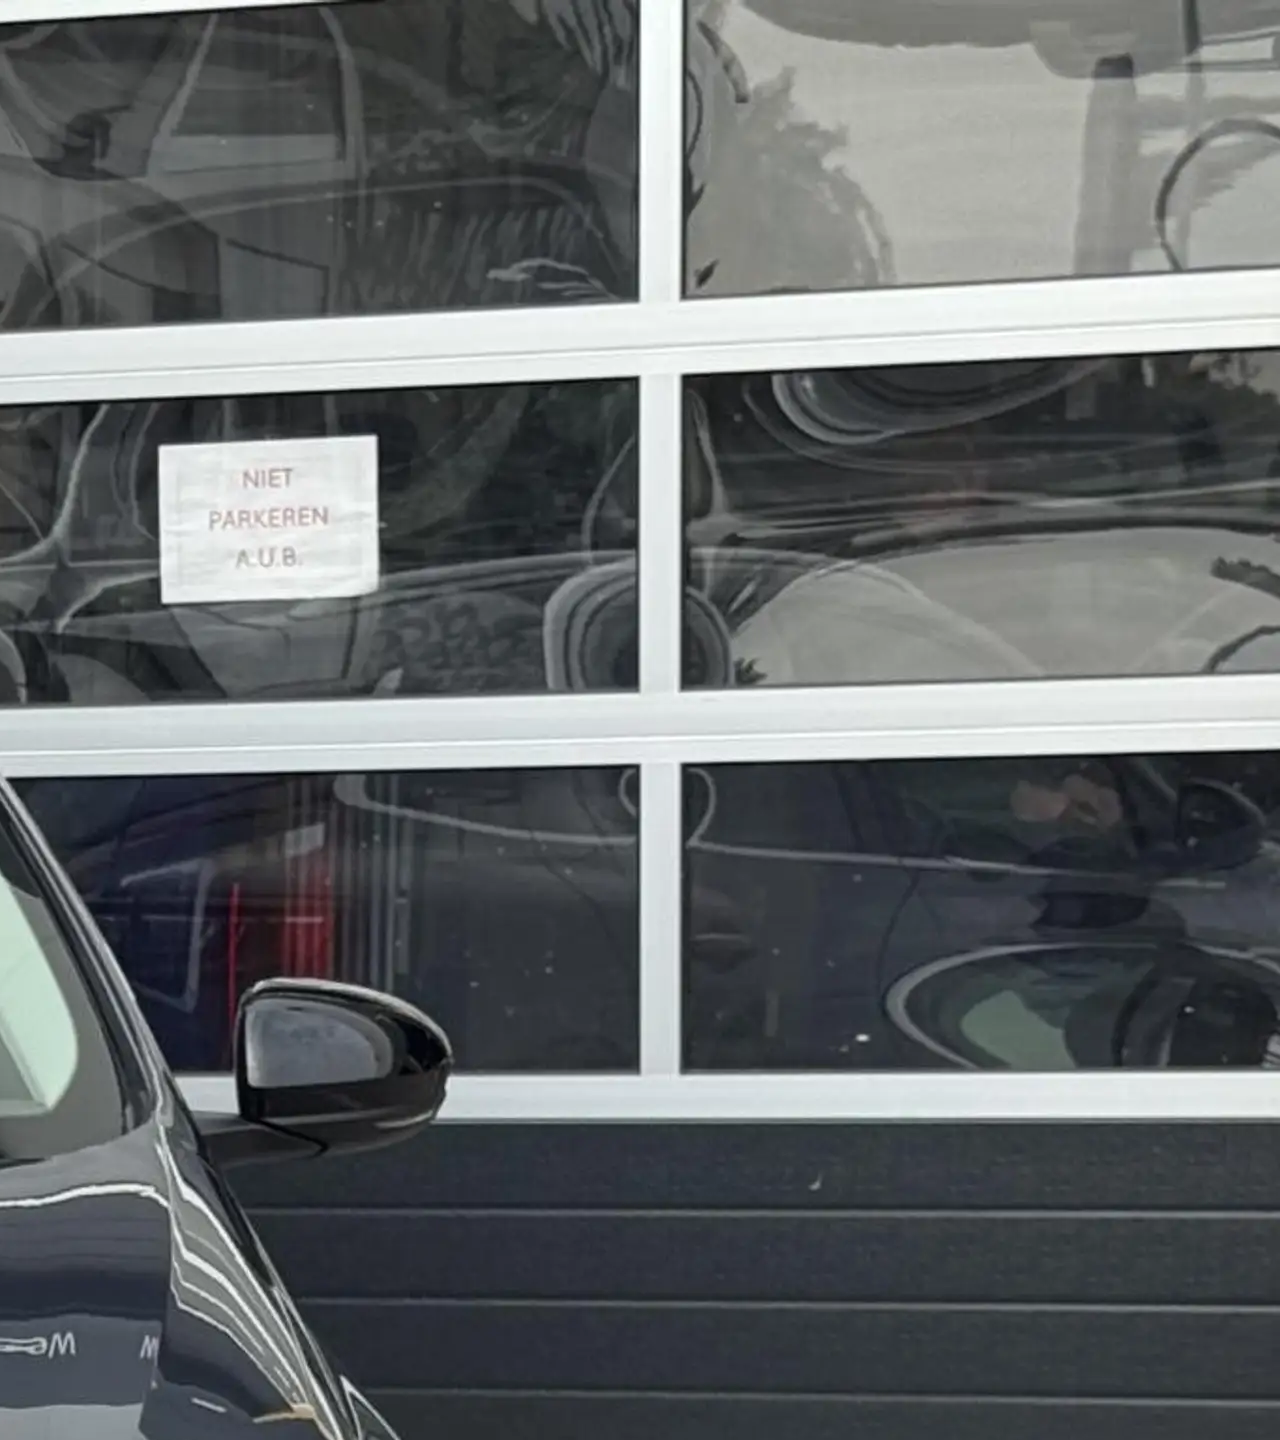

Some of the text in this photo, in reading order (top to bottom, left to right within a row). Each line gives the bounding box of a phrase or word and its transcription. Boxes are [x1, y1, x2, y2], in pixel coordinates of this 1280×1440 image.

[242, 467, 294, 489] NIET
[208, 506, 330, 531] PARKEREN
[235, 547, 303, 569] A.U.B.
